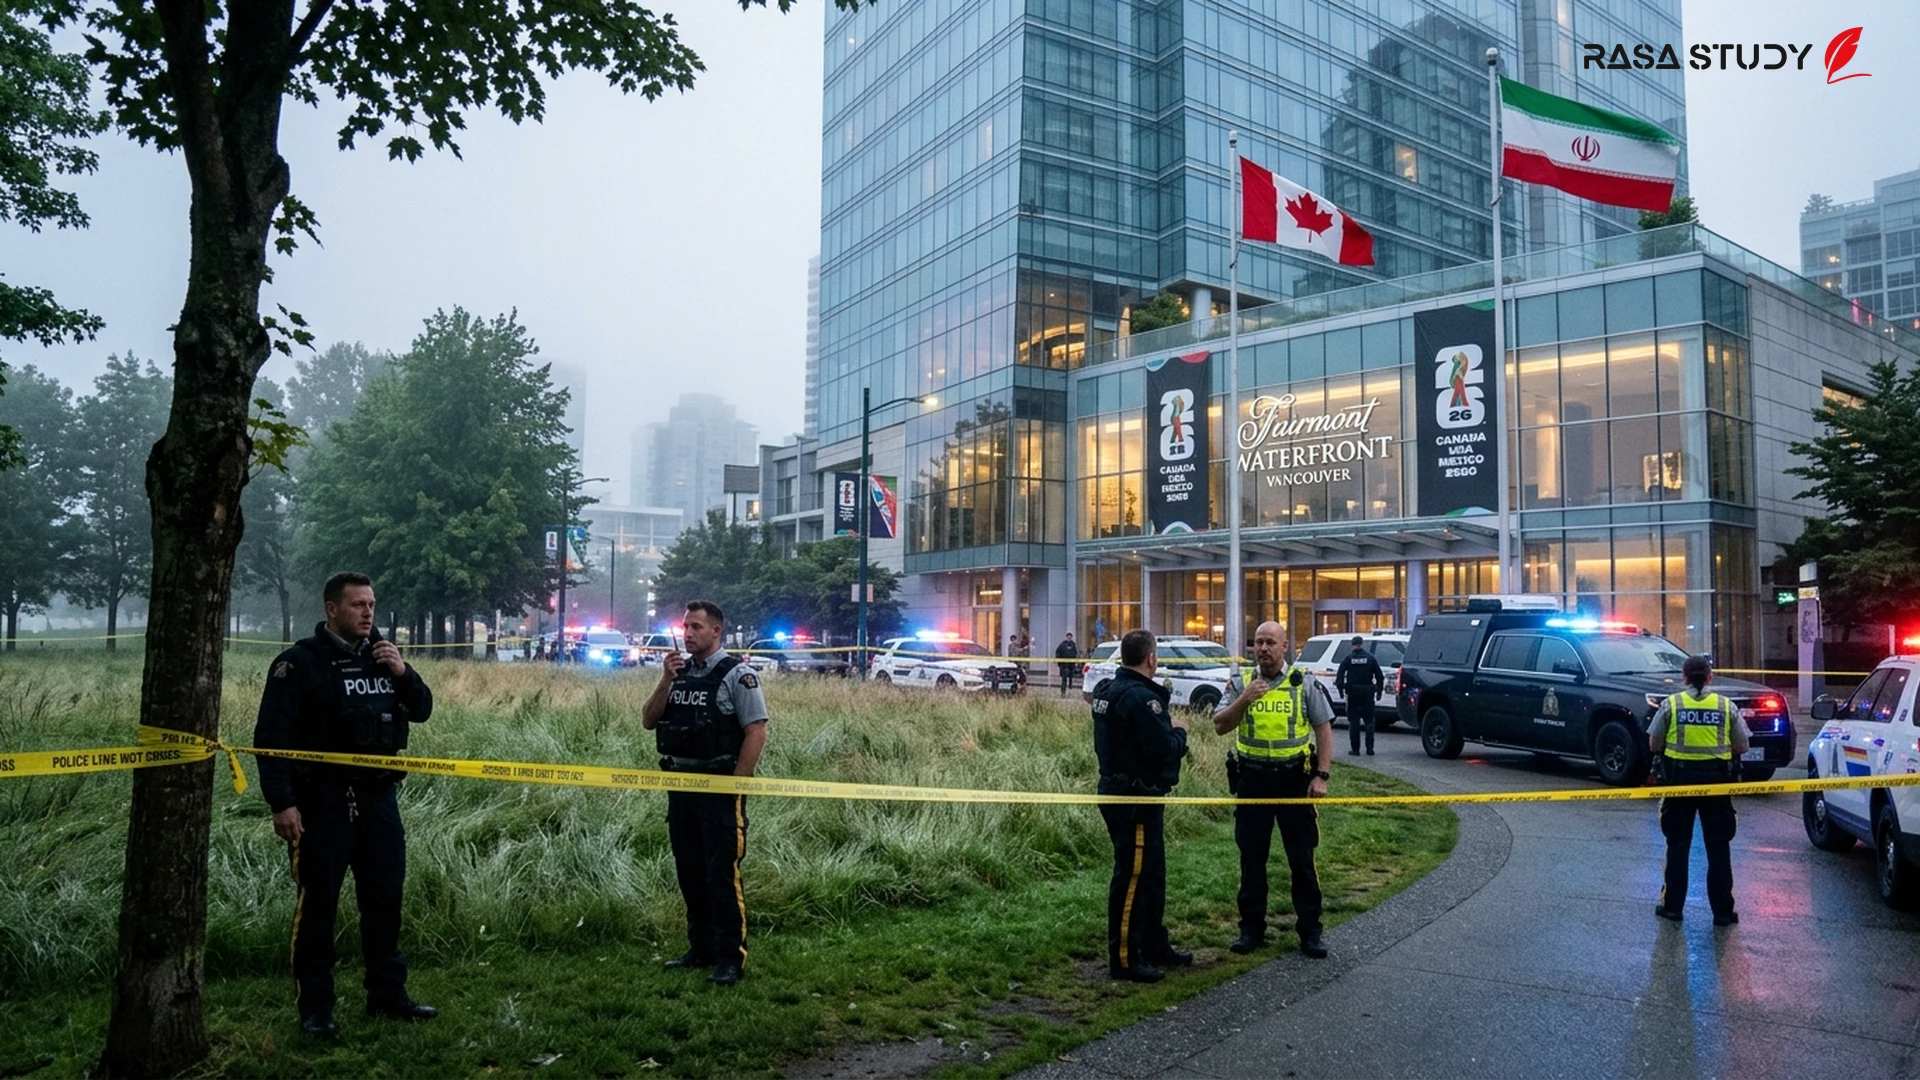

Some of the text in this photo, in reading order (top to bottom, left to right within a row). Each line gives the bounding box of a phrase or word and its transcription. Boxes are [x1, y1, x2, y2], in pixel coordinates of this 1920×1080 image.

[1237, 393, 1381, 450] Fairmont
[1266, 468, 1351, 487] VANCOUVER
[52, 755, 89, 769] POLICE
